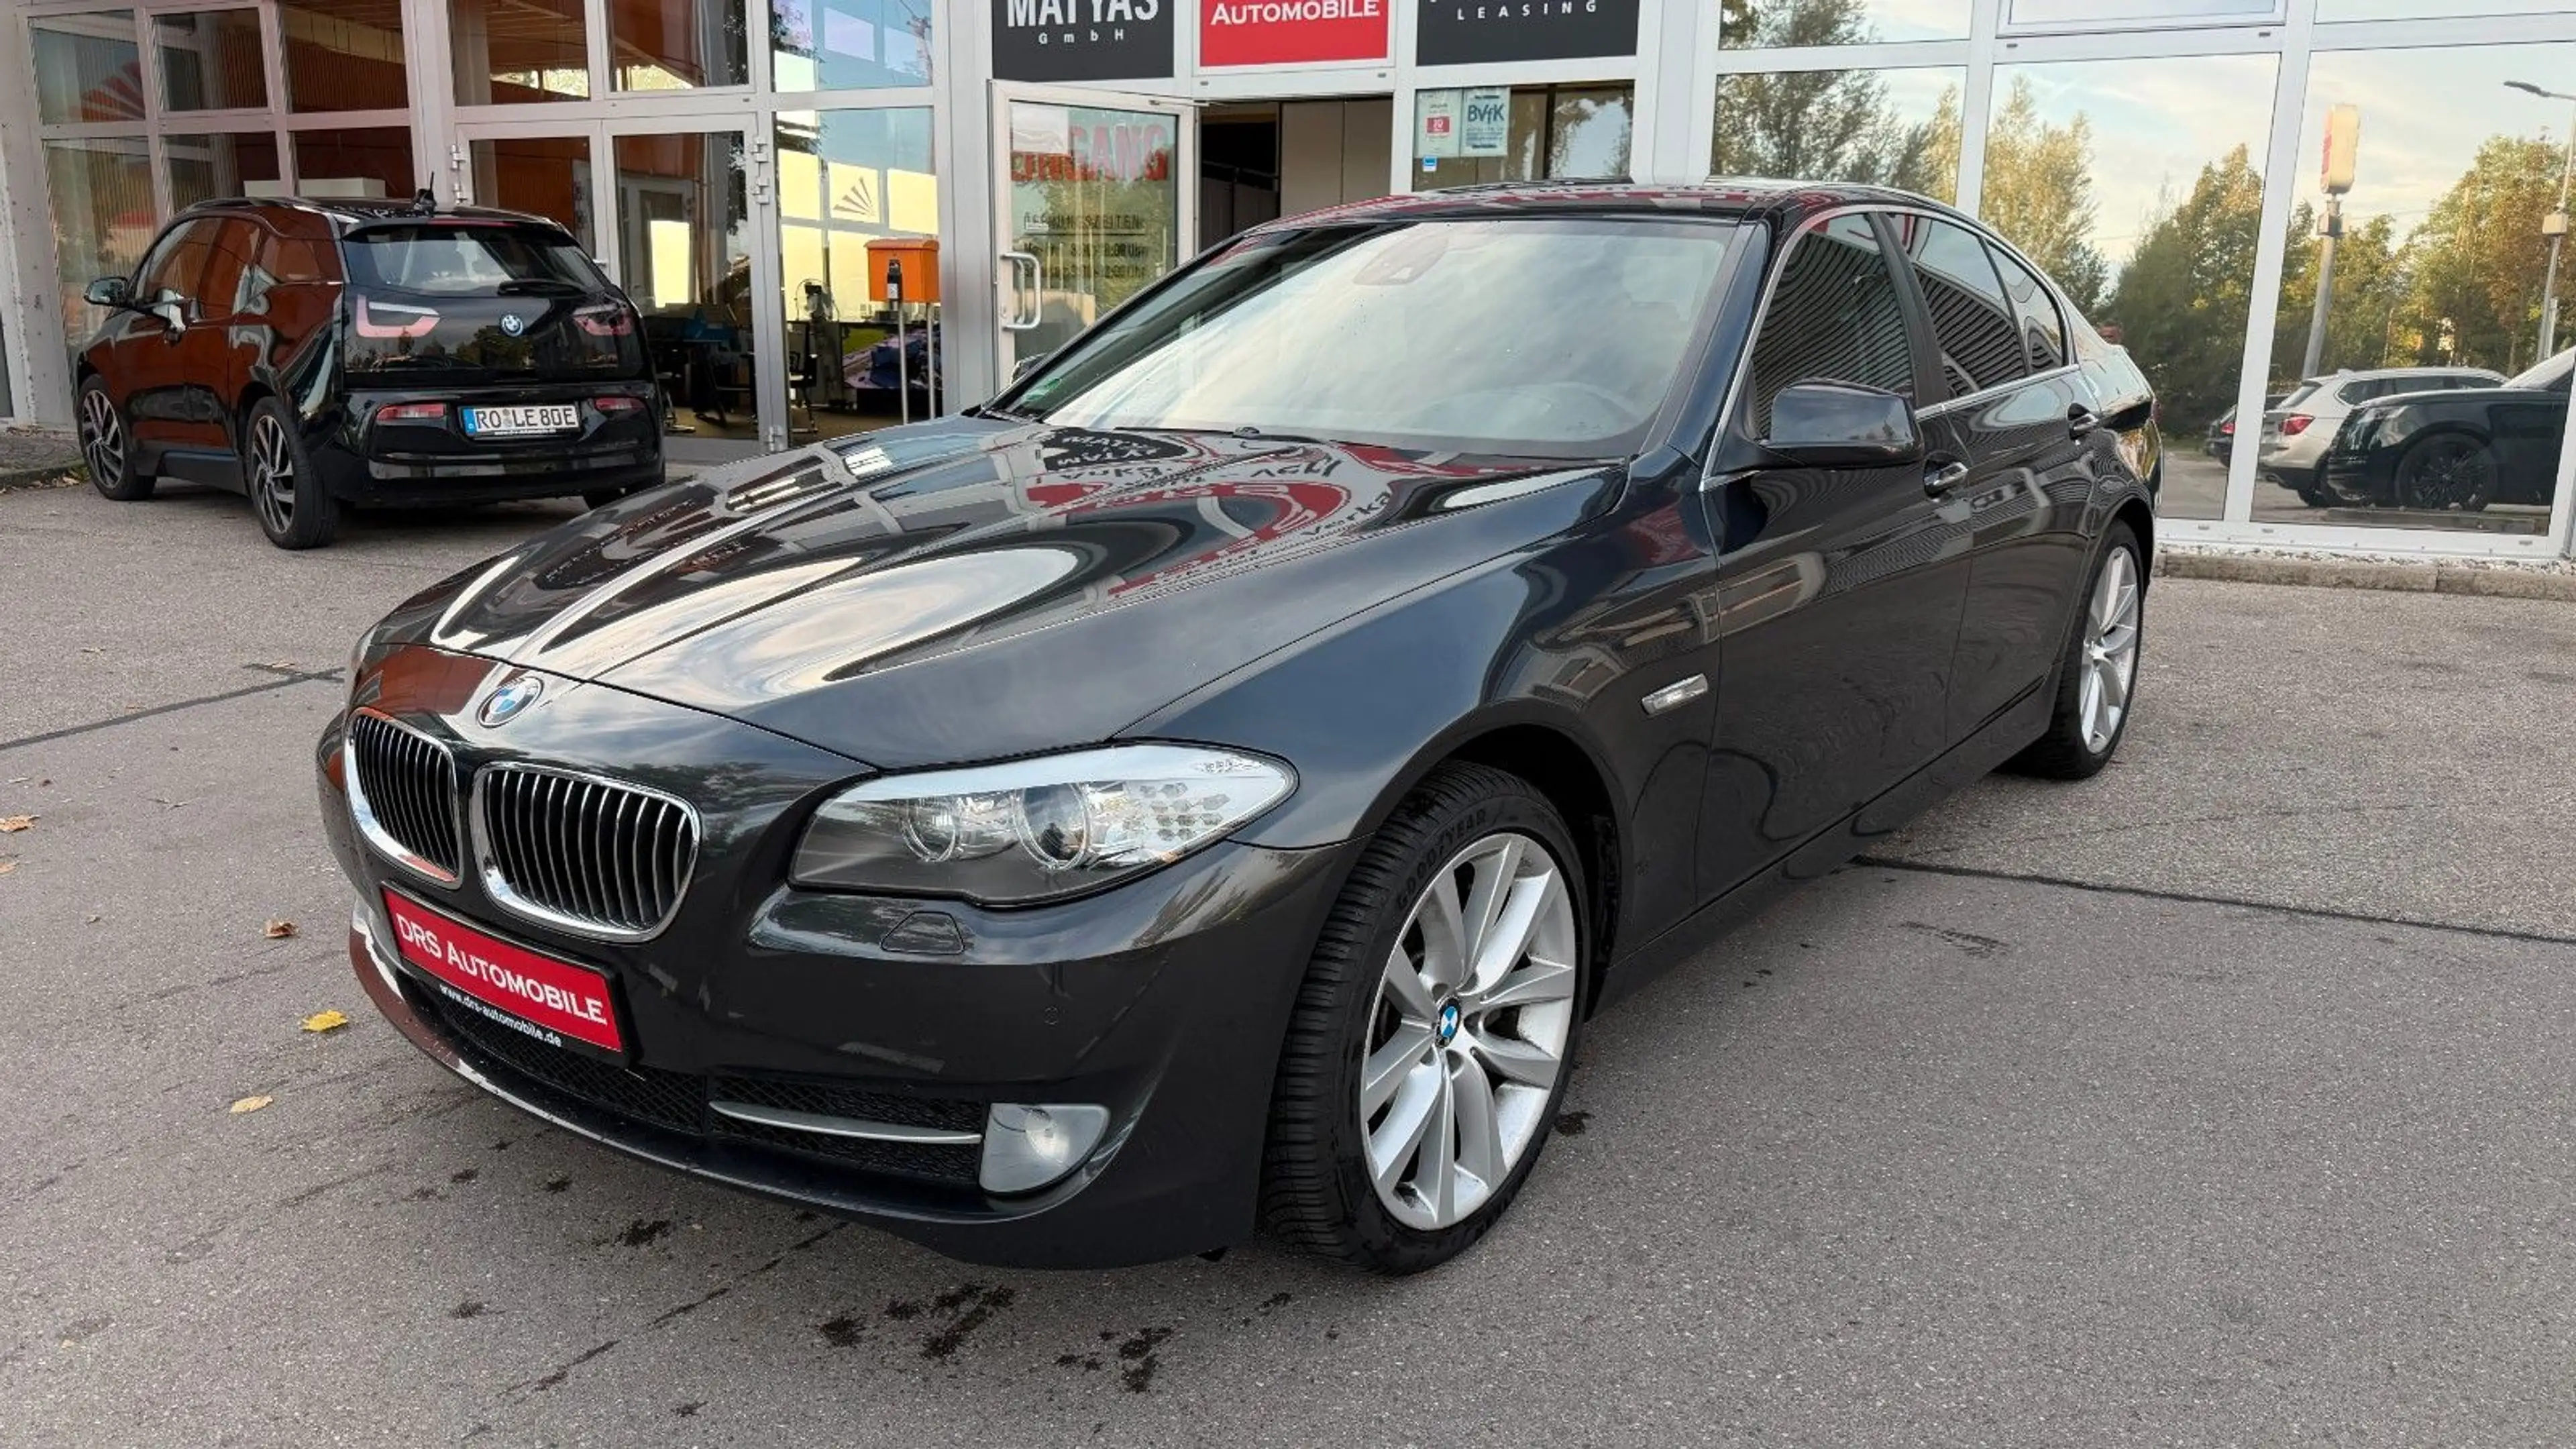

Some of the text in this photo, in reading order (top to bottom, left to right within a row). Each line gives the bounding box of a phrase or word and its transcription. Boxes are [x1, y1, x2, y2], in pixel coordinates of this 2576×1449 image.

[1210, 0, 1381, 25] AUTOMOBILE
[1456, 1, 1597, 20] LEASING
[1468, 103, 1505, 124] BVfK
[475, 410, 502, 429] RO
[396, 912, 608, 1026] DRS AUTOMOBILE
[439, 983, 562, 1048] www.drs-automobile.de
